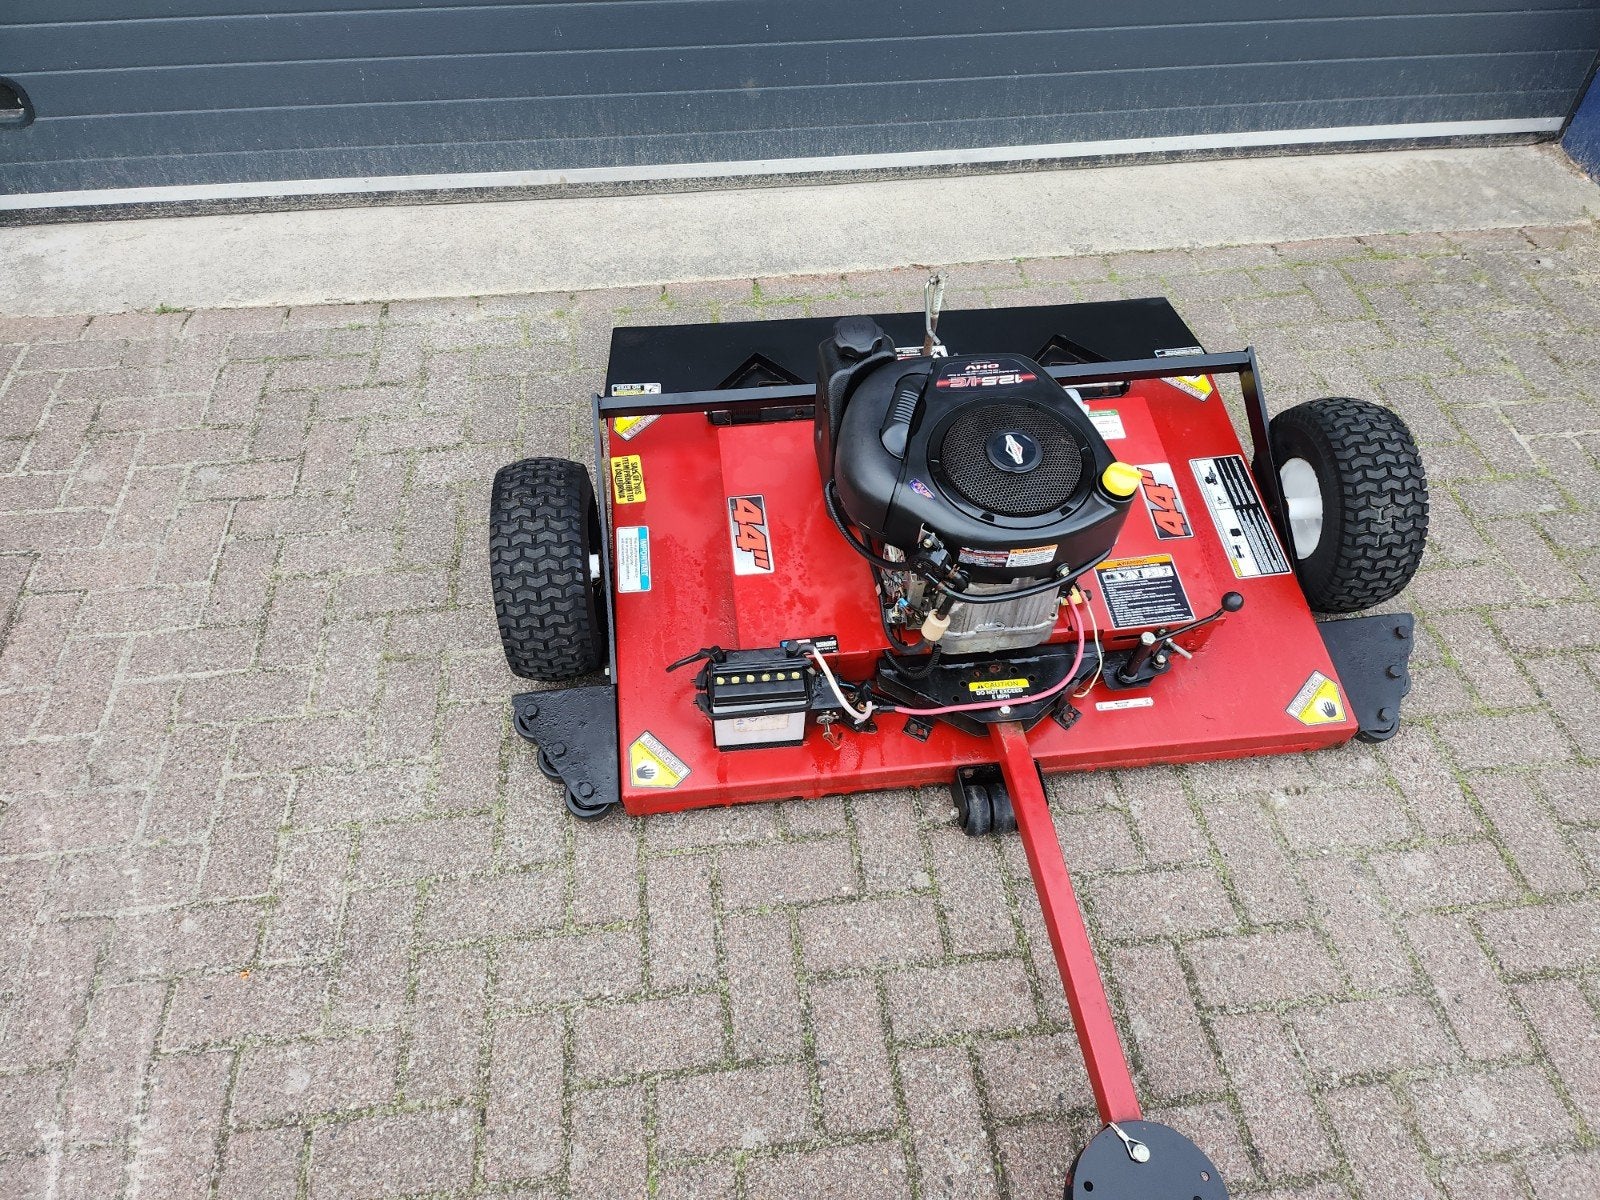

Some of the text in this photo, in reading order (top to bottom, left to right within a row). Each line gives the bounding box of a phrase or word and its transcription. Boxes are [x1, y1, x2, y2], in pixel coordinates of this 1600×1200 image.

[965, 363, 1000, 371] OHV
[639, 538, 649, 576] IMPORTANT
[984, 680, 1019, 689] CAUTION
[645, 737, 685, 773] DANGER
